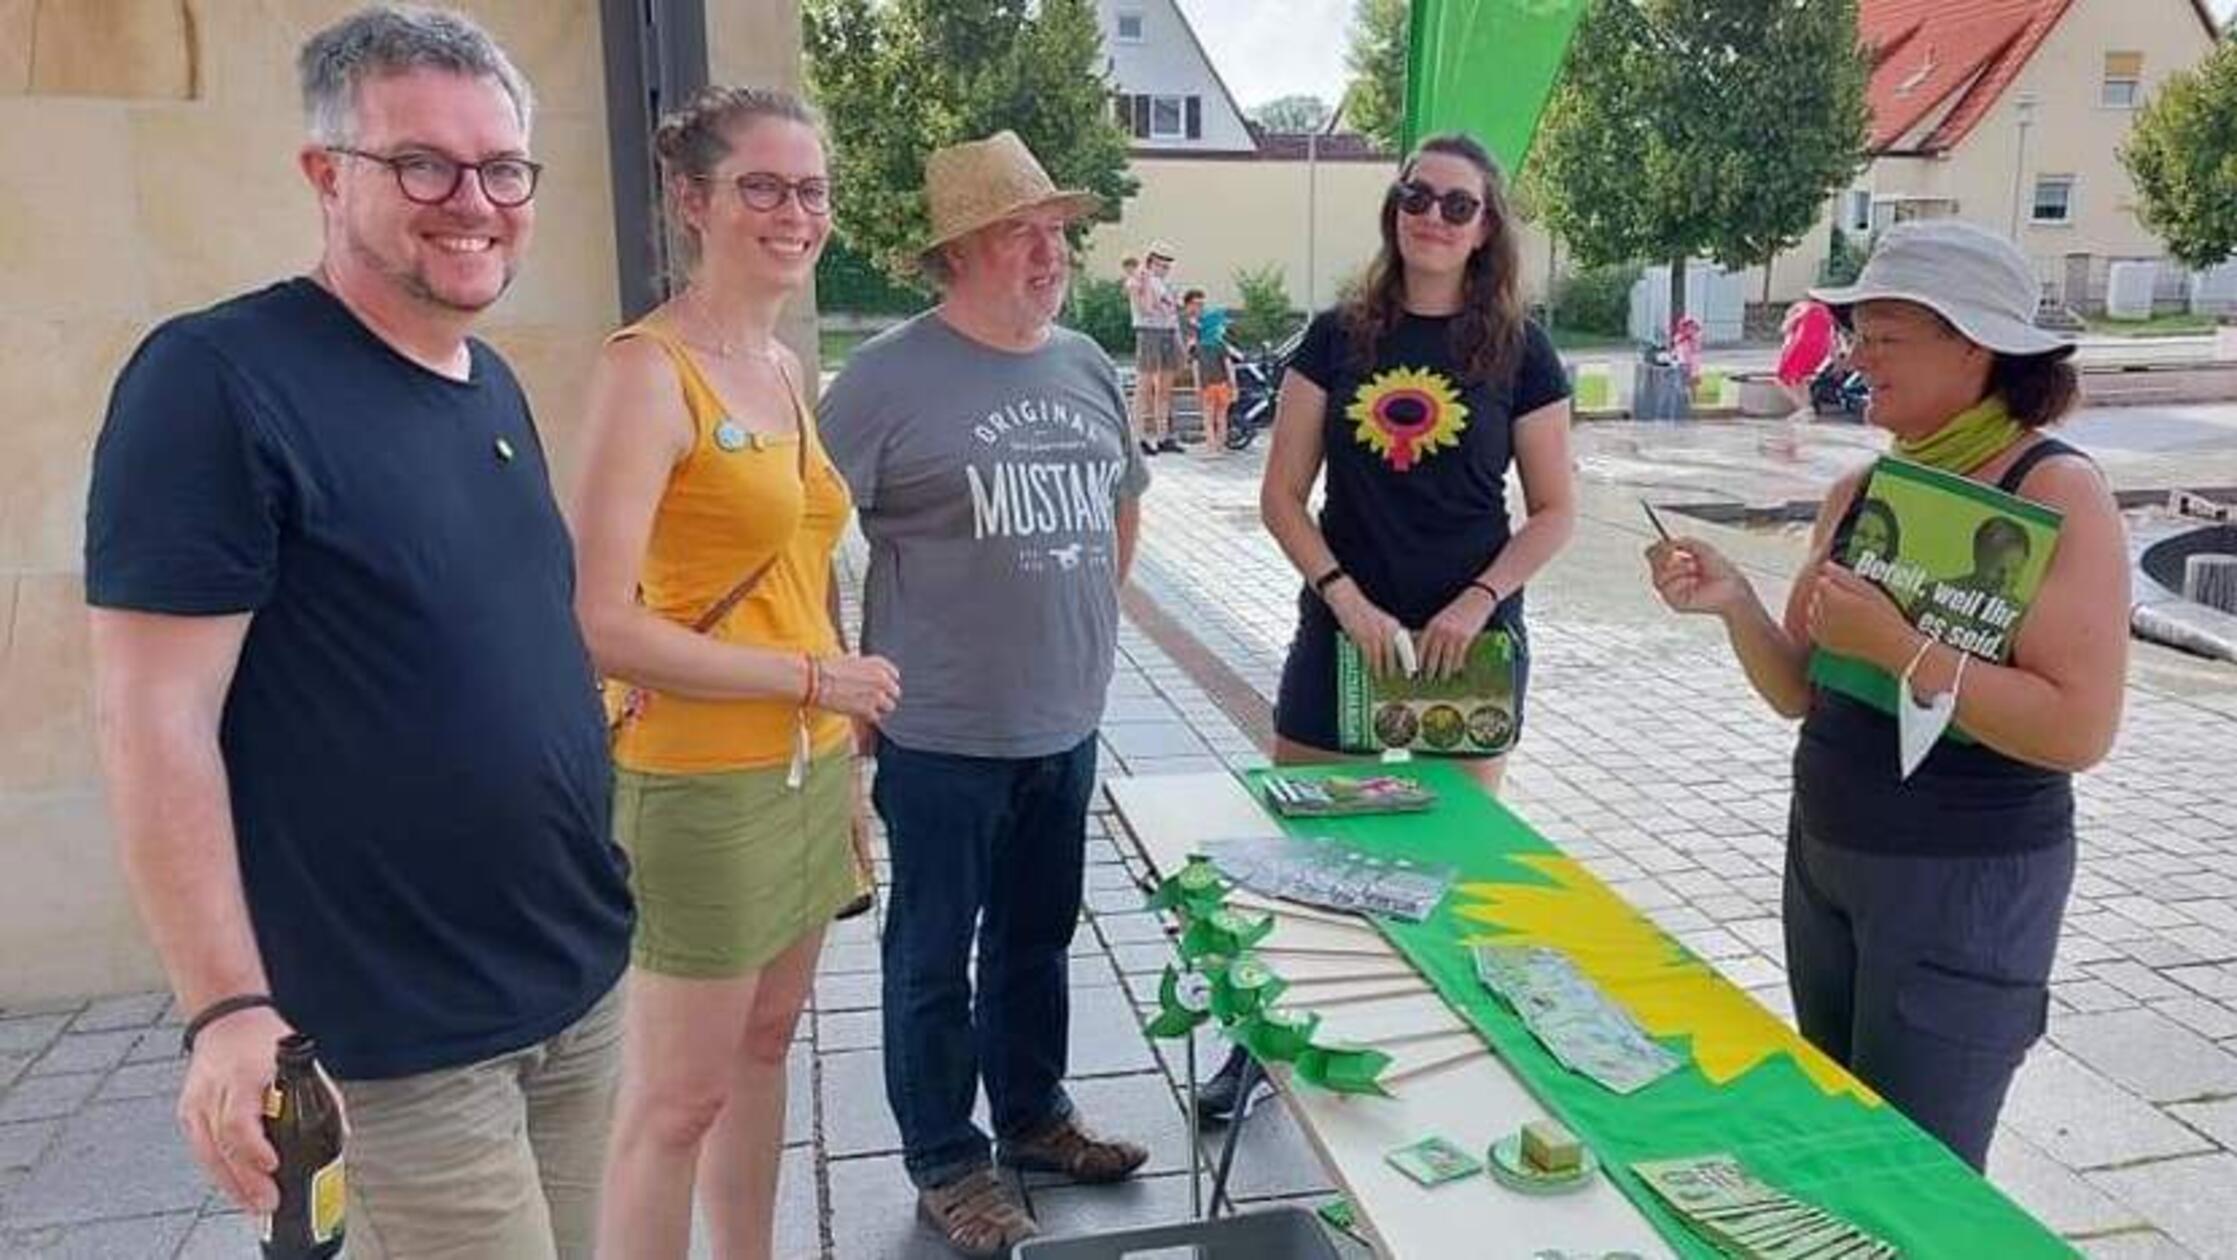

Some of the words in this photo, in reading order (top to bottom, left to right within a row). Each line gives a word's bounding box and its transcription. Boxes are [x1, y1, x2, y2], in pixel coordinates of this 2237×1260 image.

[975, 400, 1097, 443] ORIGINAL
[1933, 581, 1984, 617] weil
[1919, 613, 1947, 641] es
